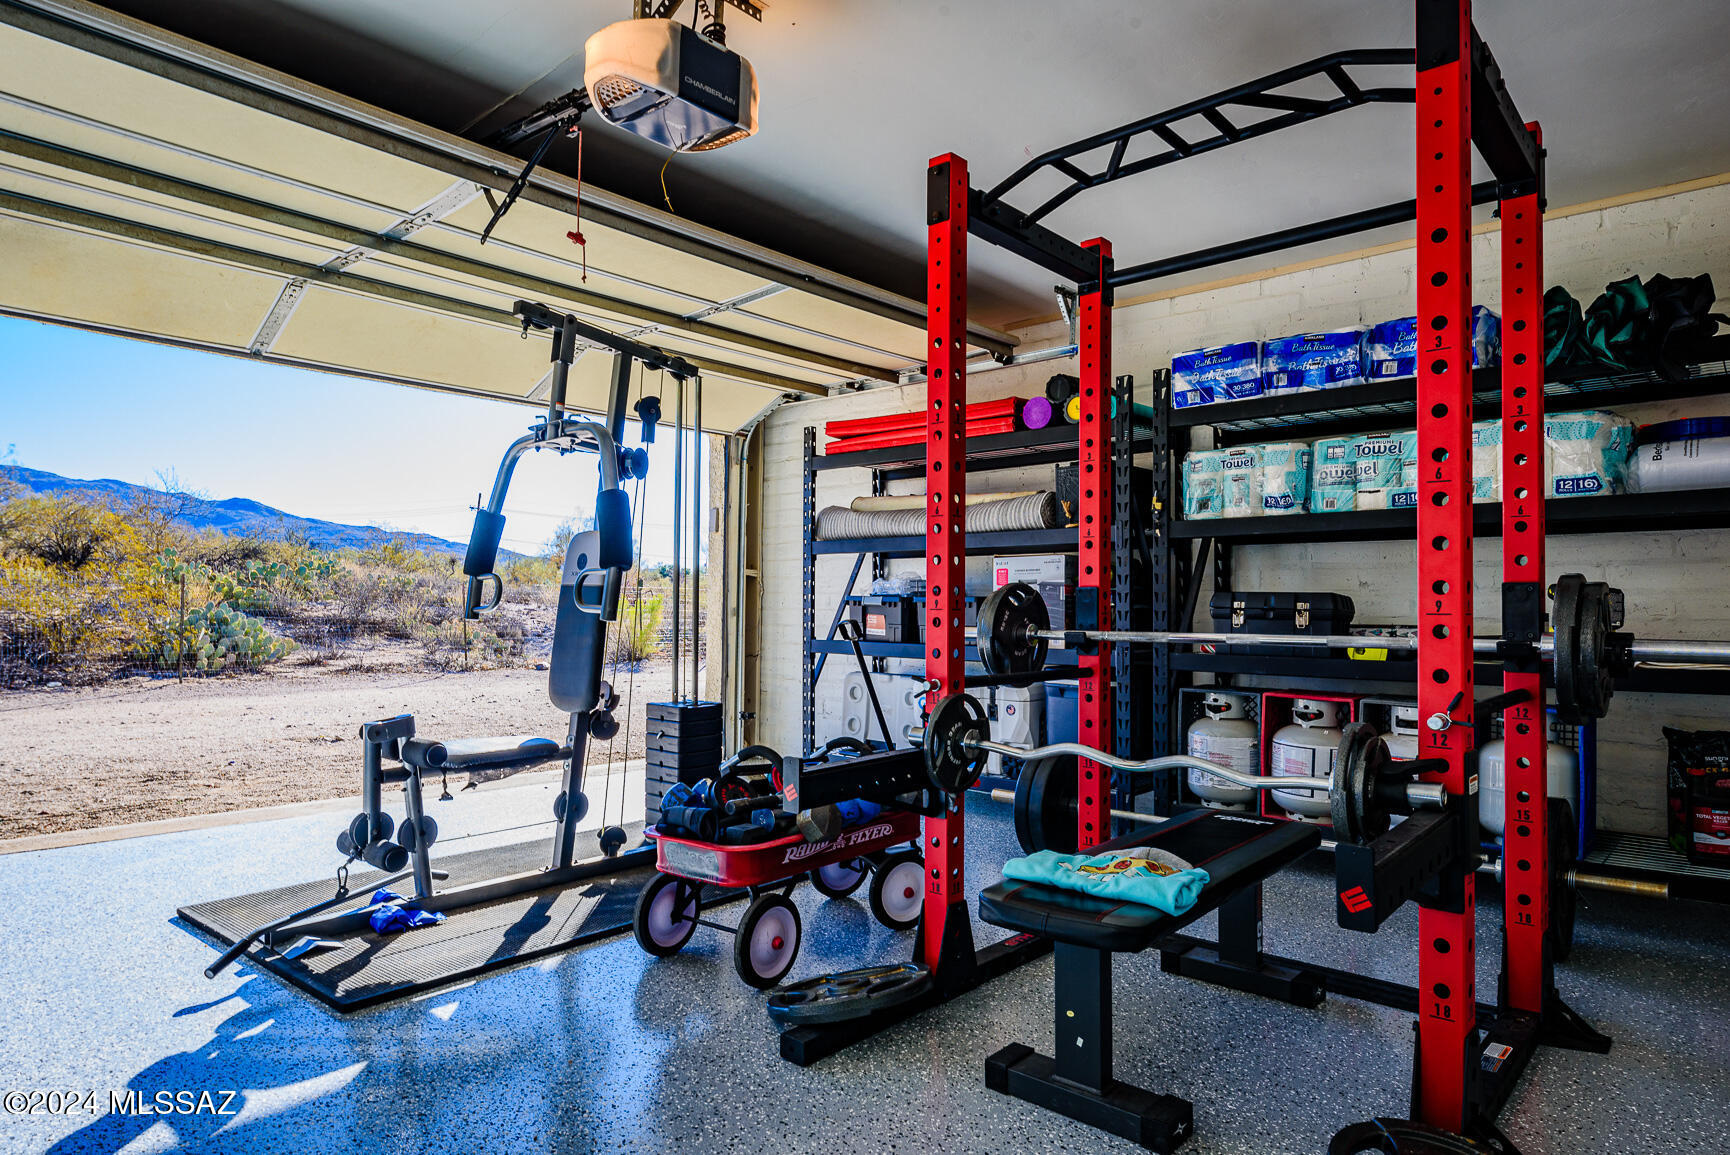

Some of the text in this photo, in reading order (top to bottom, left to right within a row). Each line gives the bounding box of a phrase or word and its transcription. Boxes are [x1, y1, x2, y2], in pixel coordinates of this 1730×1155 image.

[684, 75, 736, 106] CHAMBERLAIN
[1291, 342, 1336, 352] Bath Tissue
[1435, 335, 1442, 348] 3
[1194, 354, 1232, 369] Bath Tissue
[1517, 405, 1524, 415] 3
[1354, 440, 1404, 458] Towel
[1220, 456, 1256, 470] Towel
[1435, 467, 1442, 479] 6
[1559, 480, 1573, 489] 12
[1394, 494, 1406, 502] 12
[1518, 505, 1523, 515] 6
[1435, 600, 1442, 613] 9
[1084, 681, 1093, 690] 12
[1514, 708, 1529, 719] 12
[1431, 733, 1448, 746] 12
[1516, 810, 1530, 820] 15
[848, 823, 893, 846] FLYER
[1434, 1003, 1451, 1018] 18
